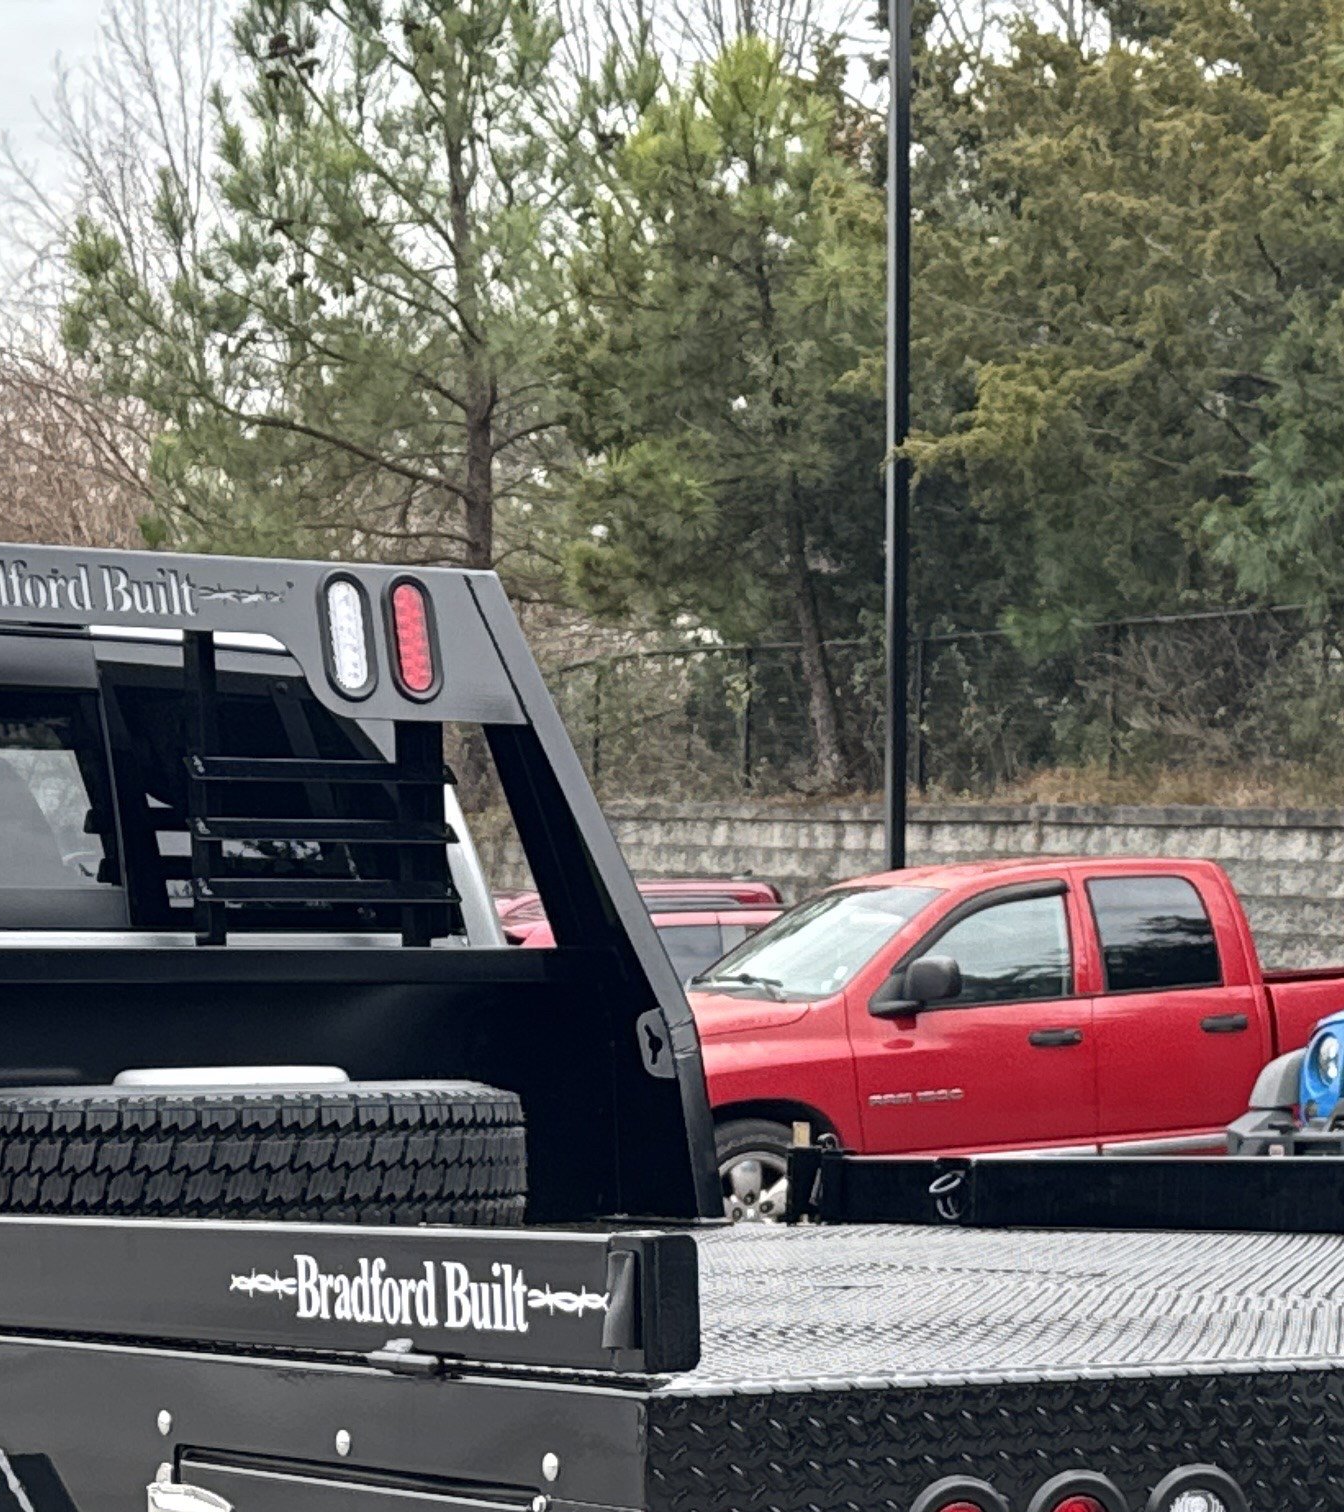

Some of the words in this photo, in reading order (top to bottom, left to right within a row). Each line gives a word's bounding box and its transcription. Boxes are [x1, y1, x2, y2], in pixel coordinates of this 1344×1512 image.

[98, 564, 197, 617] Built
[293, 1253, 439, 1328] Bradford
[442, 1260, 529, 1334] Built
